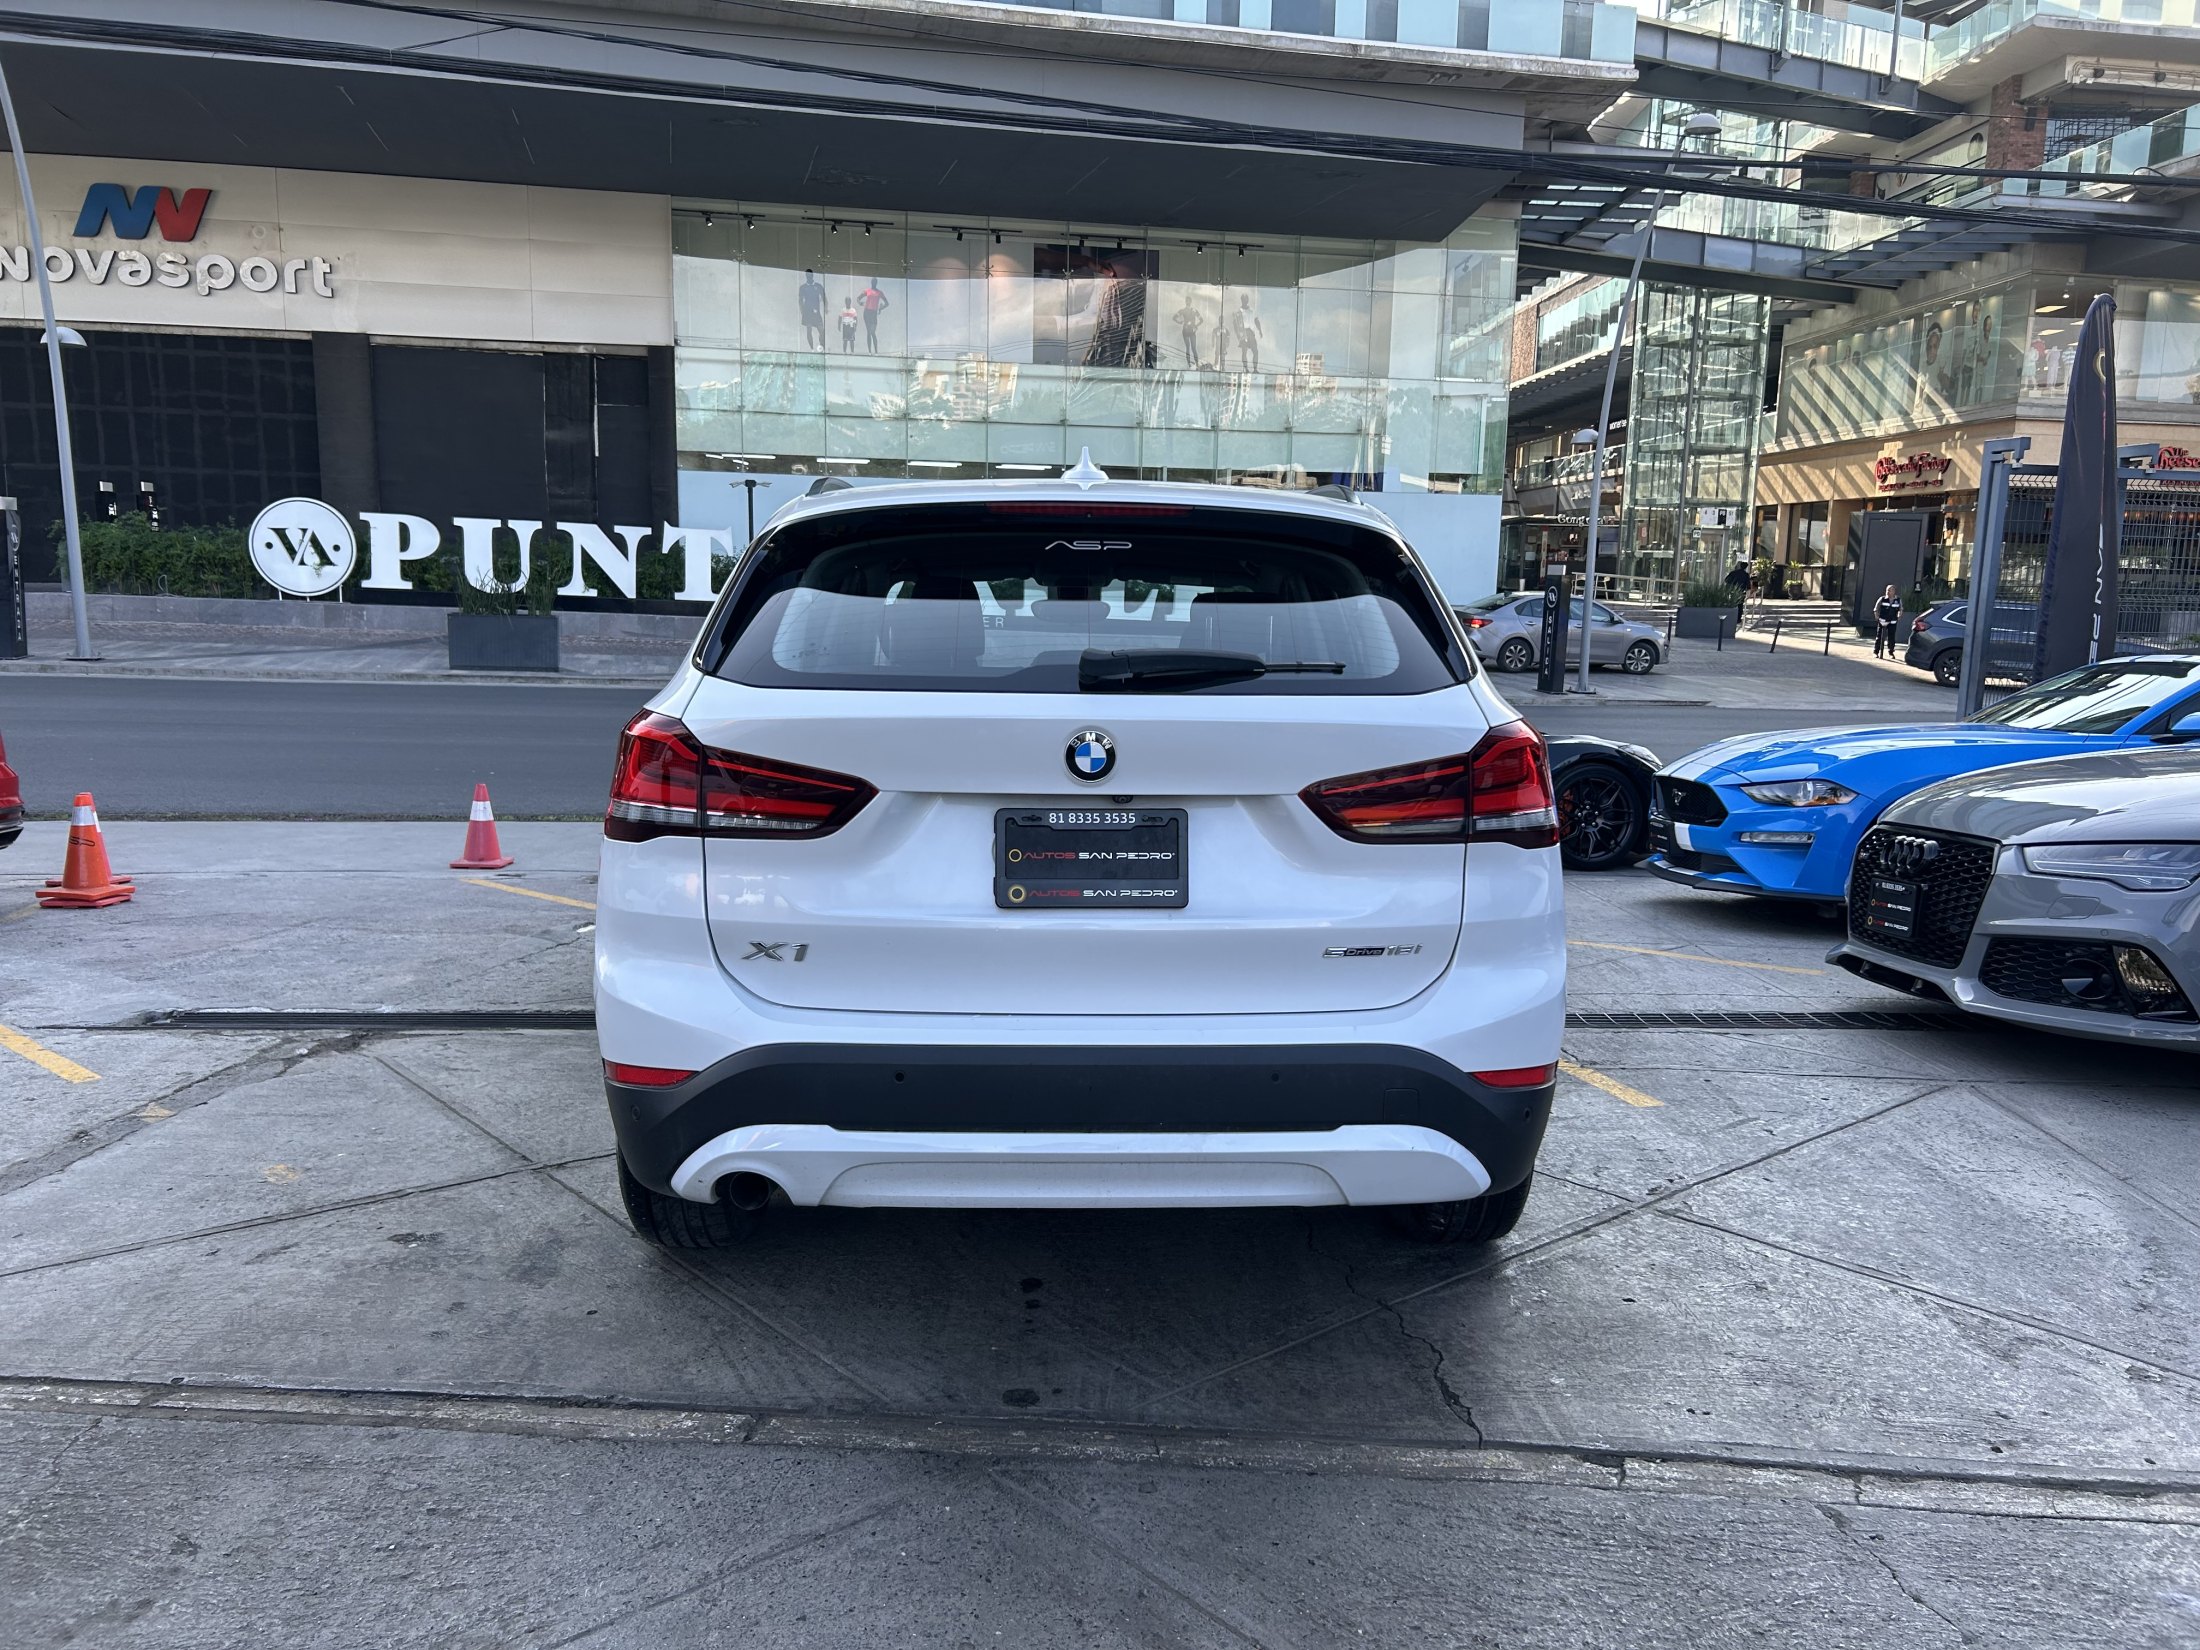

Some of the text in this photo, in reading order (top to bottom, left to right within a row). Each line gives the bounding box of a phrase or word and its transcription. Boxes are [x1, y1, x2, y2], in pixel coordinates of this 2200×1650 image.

[1557, 513, 1585, 528] Gong
[1070, 731, 1113, 751] BMW
[1049, 813, 1136, 824] 81 8335 3535
[1023, 852, 1076, 860] AUTOS
[1078, 852, 1112, 860] SAN
[1029, 889, 1081, 898] AUTOS
[1083, 889, 1117, 898] SAN
[741, 942, 809, 961] X1
